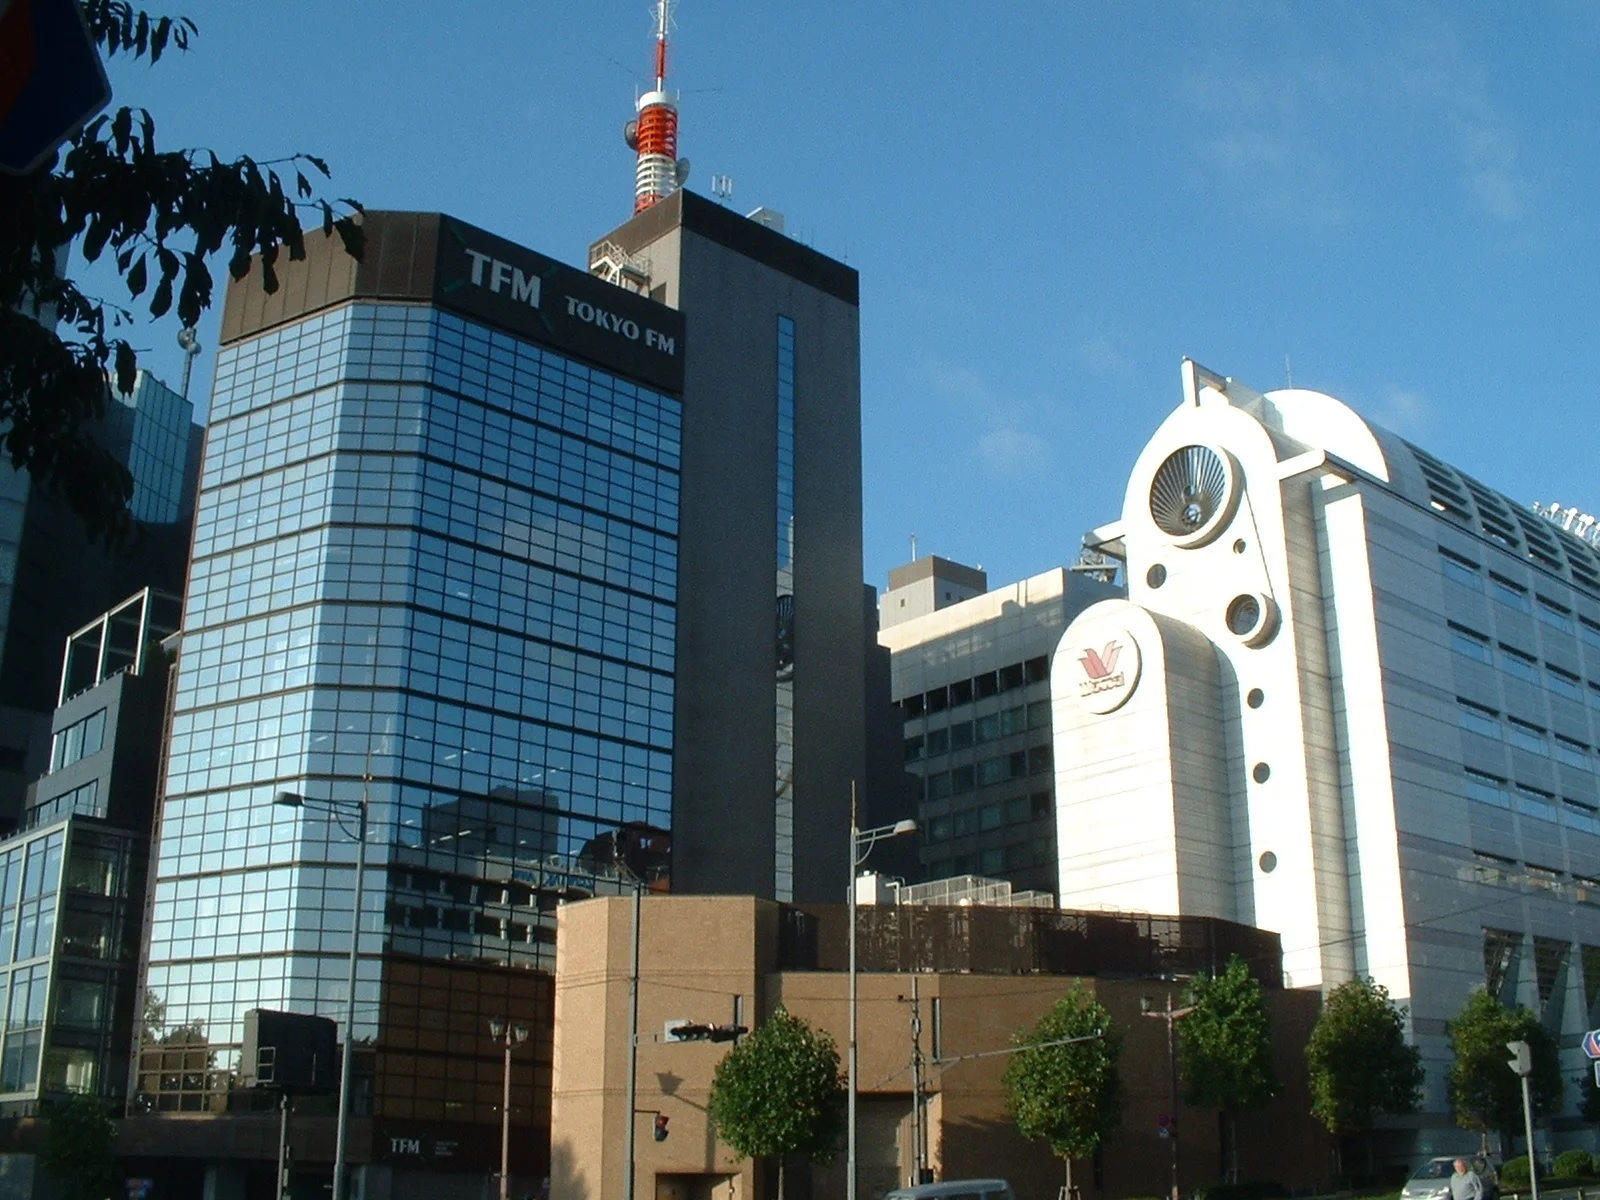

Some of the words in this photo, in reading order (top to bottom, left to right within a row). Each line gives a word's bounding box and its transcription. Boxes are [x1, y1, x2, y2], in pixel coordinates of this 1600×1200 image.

[464, 248, 541, 309] TFM
[564, 295, 640, 340] TOKYO
[645, 327, 675, 356] FM
[390, 1138, 420, 1154] TFM
